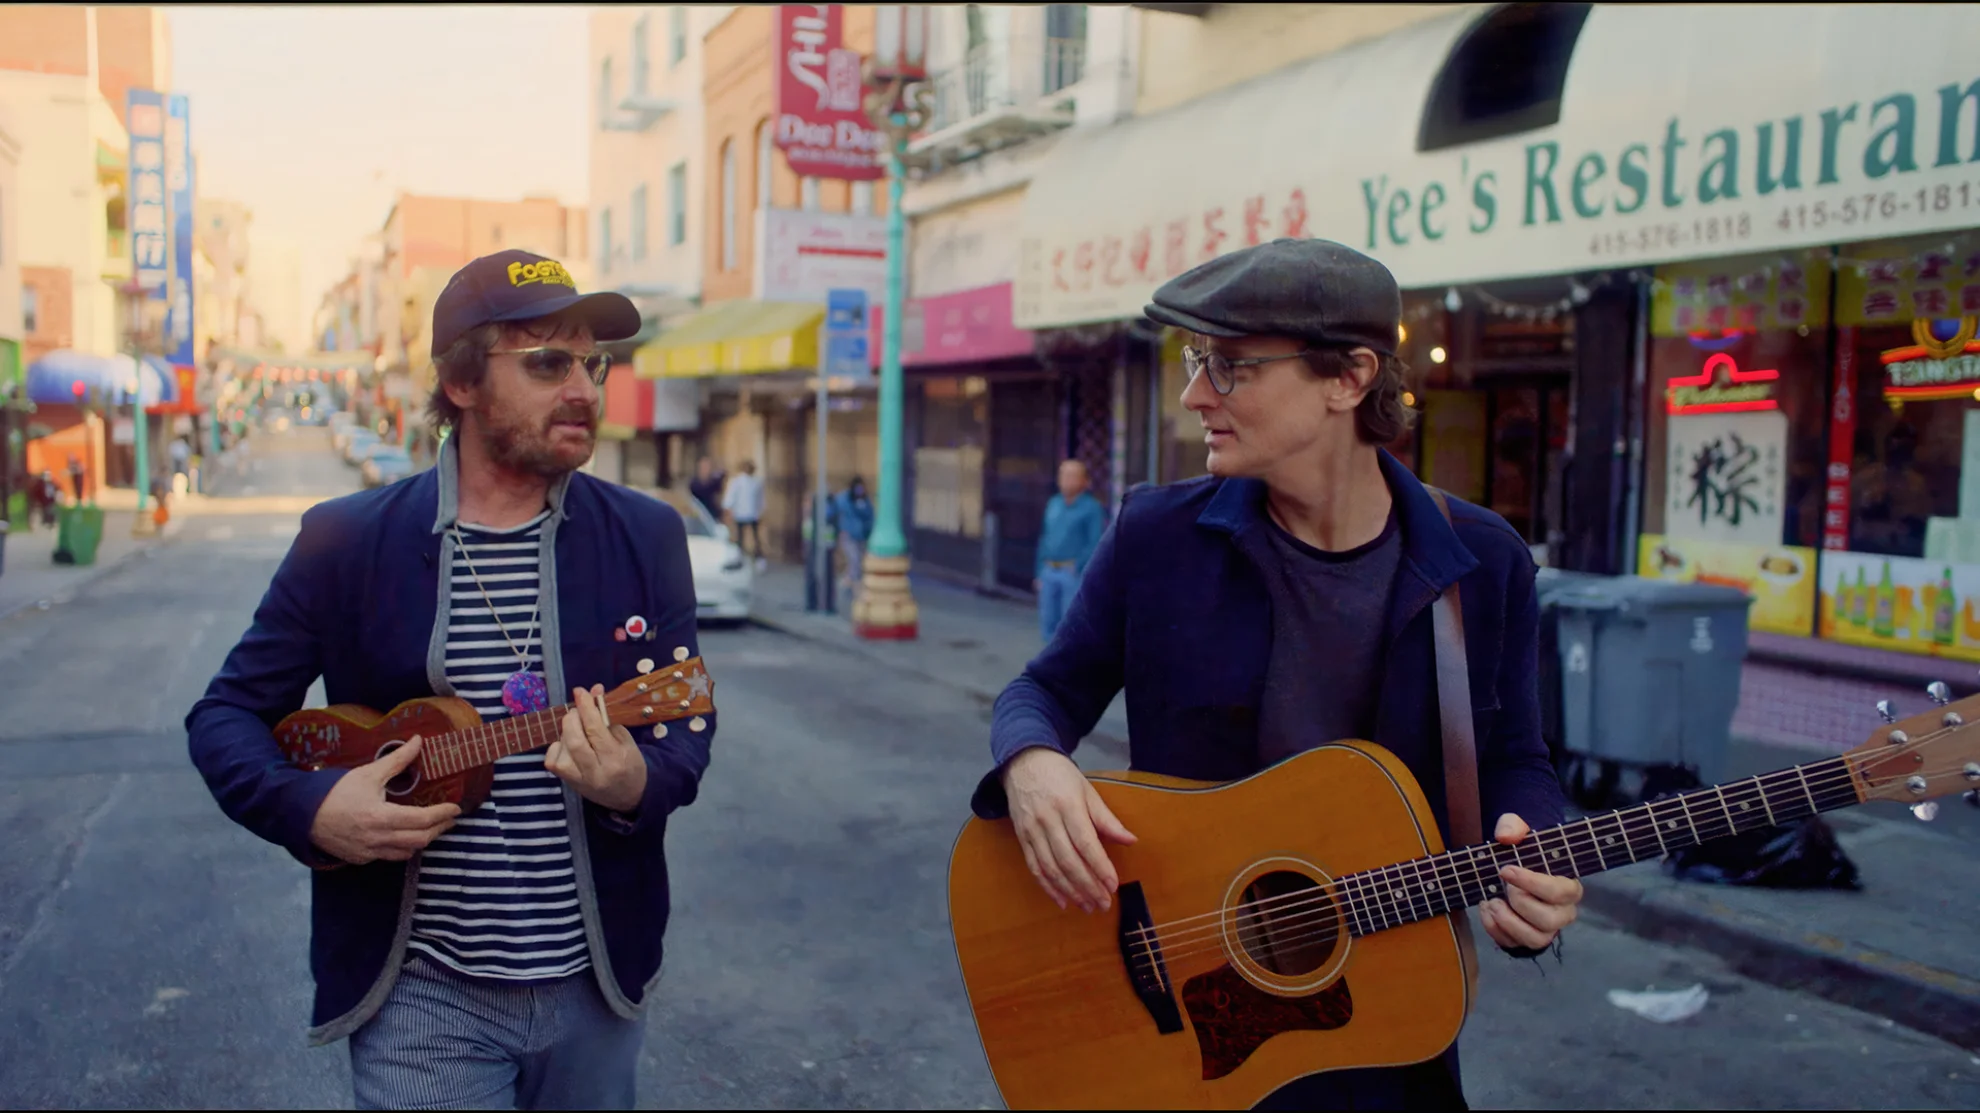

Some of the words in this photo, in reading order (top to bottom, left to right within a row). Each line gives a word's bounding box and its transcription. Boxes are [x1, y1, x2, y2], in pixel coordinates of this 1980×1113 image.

[1361, 155, 1497, 250] Yee's
[1776, 181, 1980, 231] 415-576-181
[1686, 432, 1760, 528] 粽
